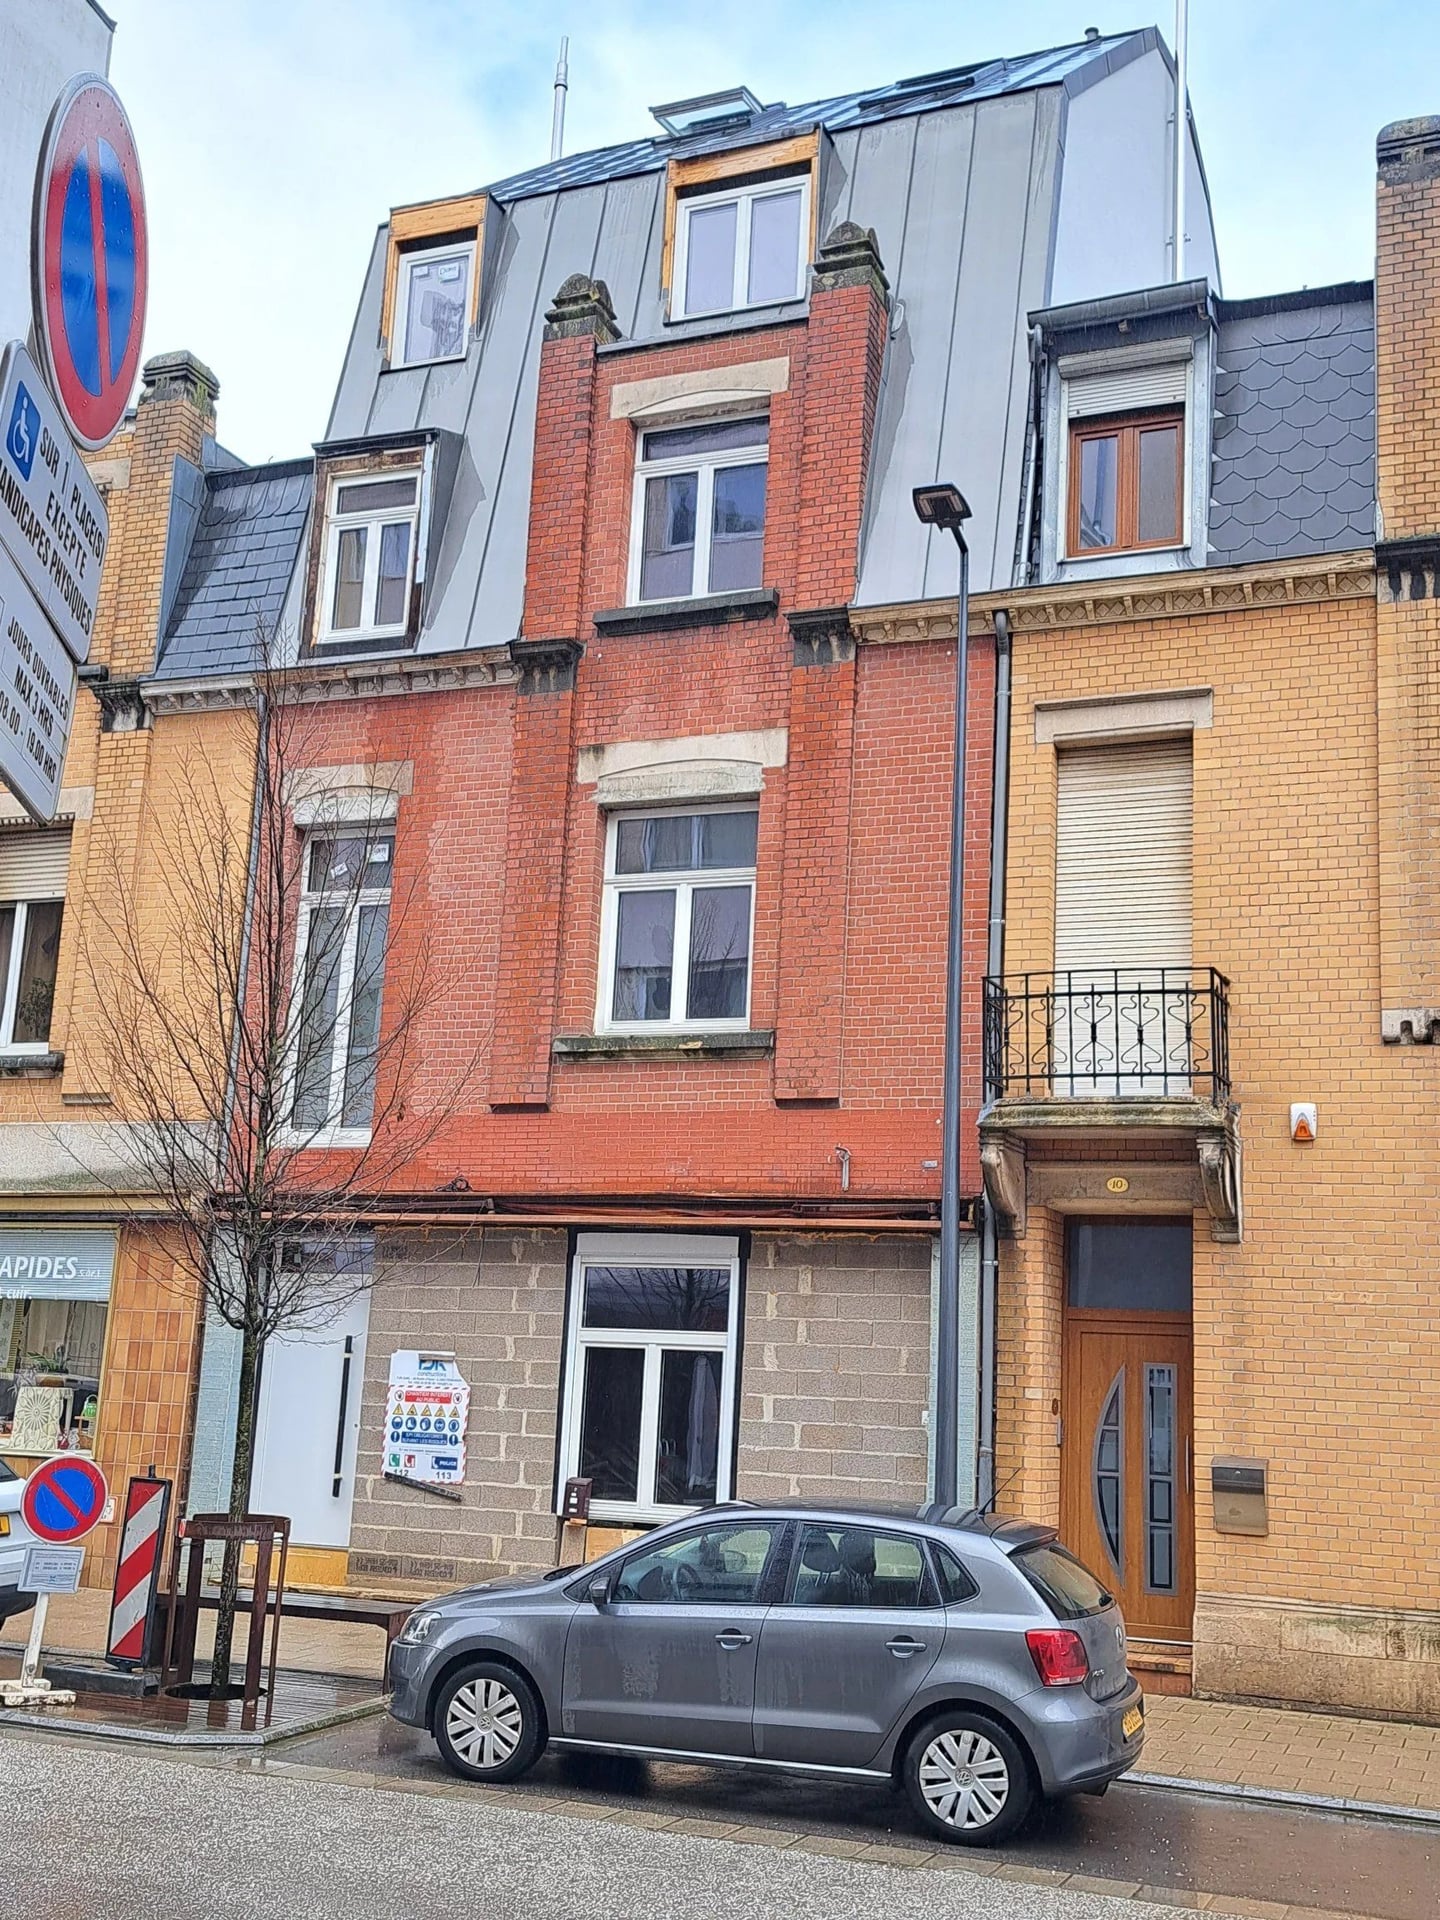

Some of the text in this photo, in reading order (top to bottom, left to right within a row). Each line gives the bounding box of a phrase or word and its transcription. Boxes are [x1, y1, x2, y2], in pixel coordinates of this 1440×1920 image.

[40, 427, 105, 568] SUR 1 PLACE(S)
[46, 489, 87, 580] EXCEPTE
[0, 456, 93, 636] ANDICAPES PHYSIQUES
[7, 615, 70, 722] JOURS OUVRABLES
[14, 664, 54, 738] MAX 3 HRS
[25, 727, 45, 766] 19.00
[43, 750, 57, 784] HRS
[436, 1472, 452, 1480] 113
